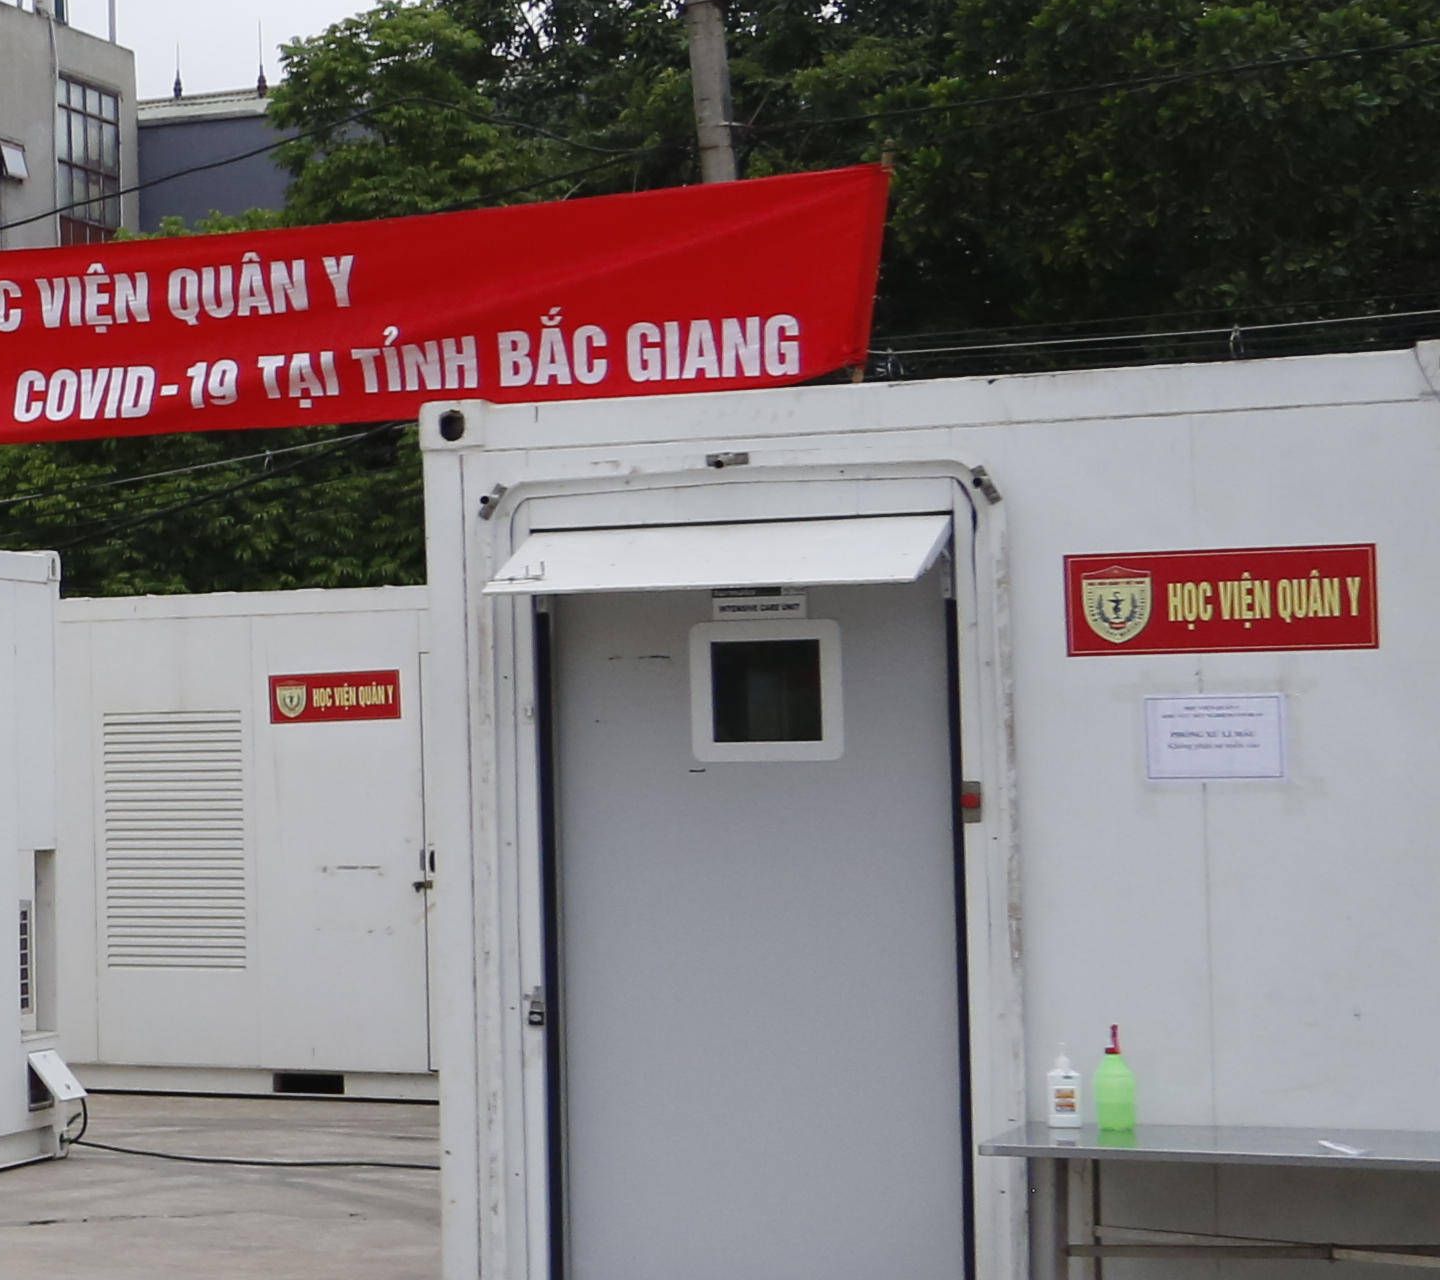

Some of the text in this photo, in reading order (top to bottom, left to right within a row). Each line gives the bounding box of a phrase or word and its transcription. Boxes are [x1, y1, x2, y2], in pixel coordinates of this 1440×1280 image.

[35, 262, 150, 334] VIỆN
[167, 252, 308, 326] QUÂN
[322, 254, 354, 308] Y
[13, 358, 239, 423] COVID-19
[257, 351, 340, 409] TẠI
[350, 325, 478, 394] TỈNH
[498, 306, 608, 387] BẮC
[626, 314, 800, 382] GIANG
[1167, 569, 1362, 630] HỌC VIỆN QUÂN Y
[312, 681, 395, 711] HỌC VIỆN QUÂN Y
